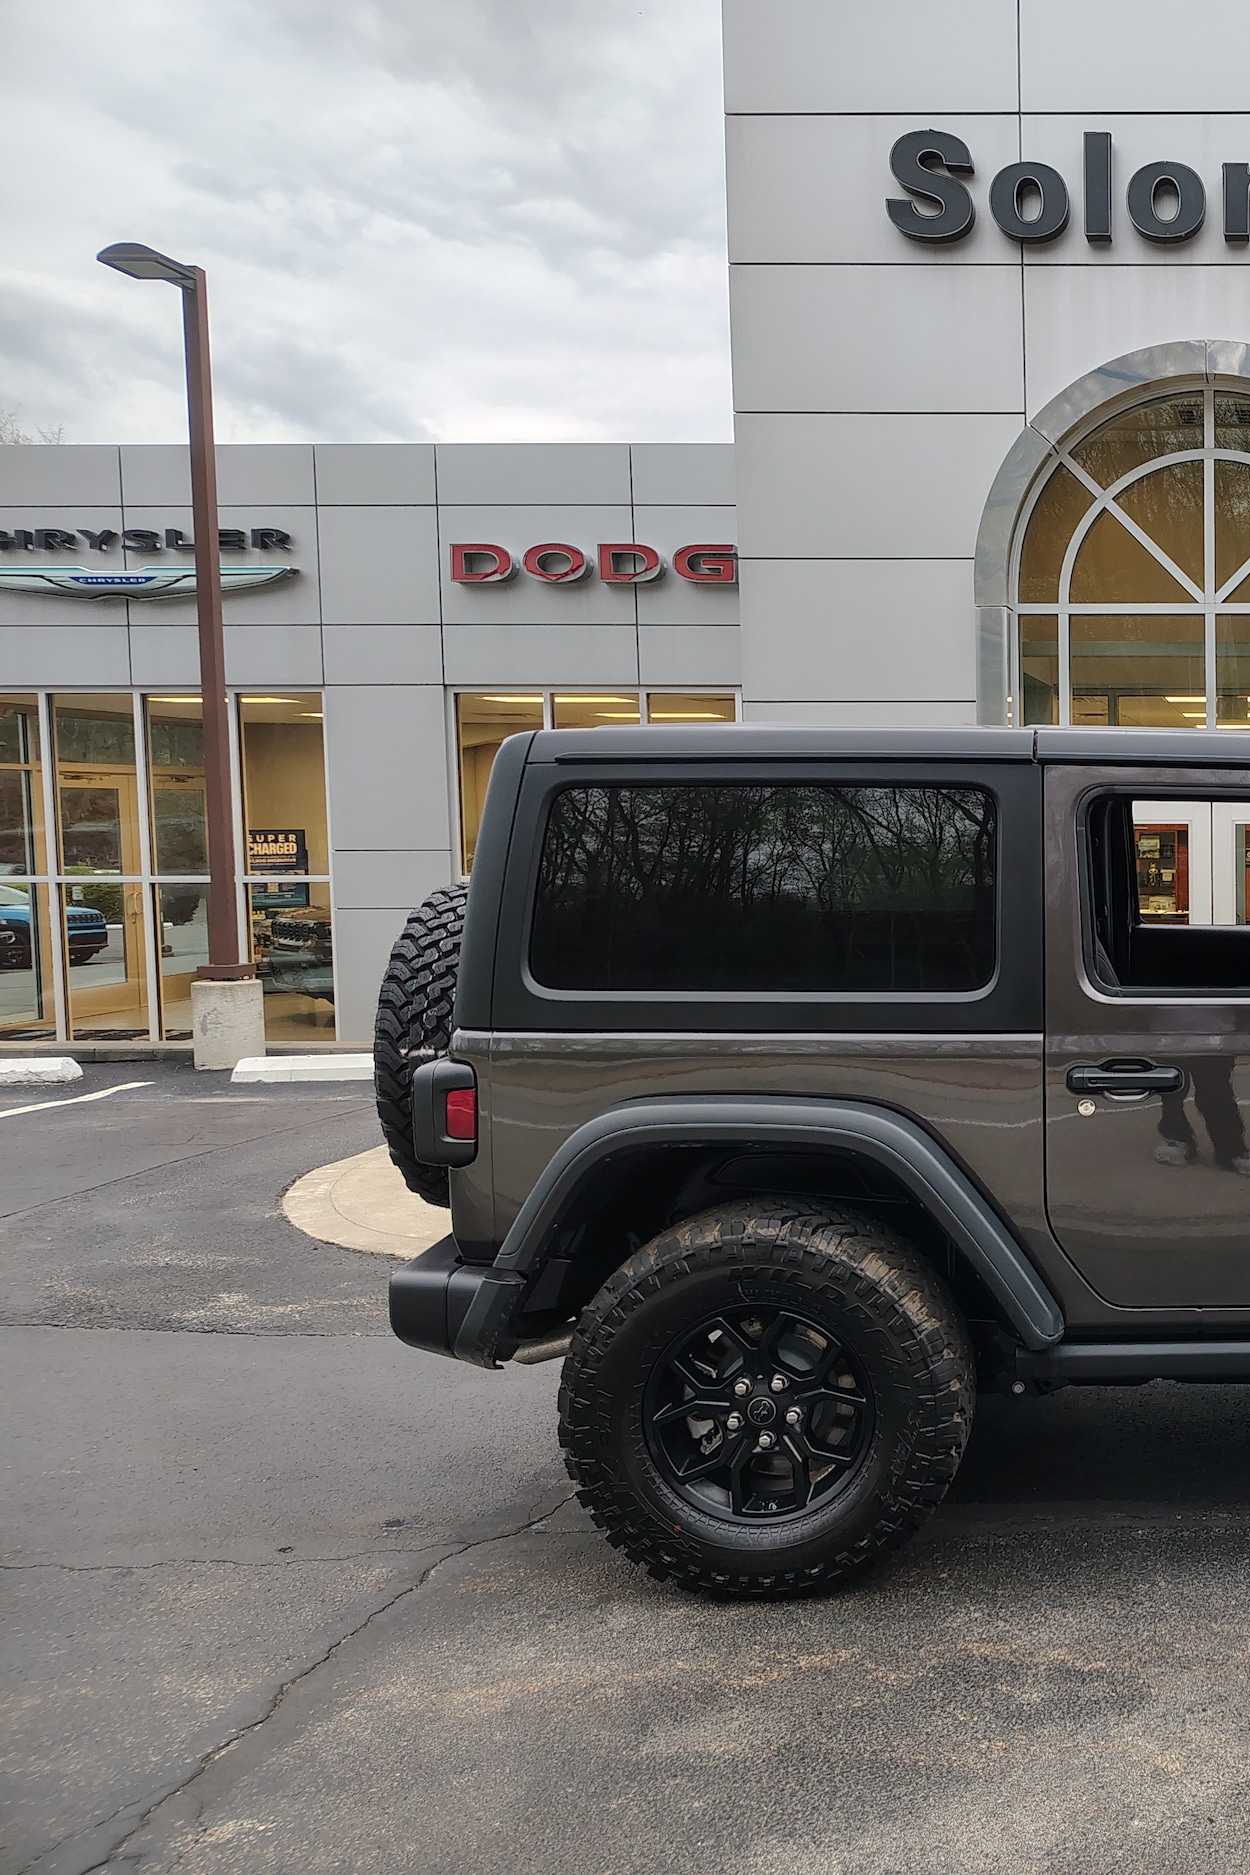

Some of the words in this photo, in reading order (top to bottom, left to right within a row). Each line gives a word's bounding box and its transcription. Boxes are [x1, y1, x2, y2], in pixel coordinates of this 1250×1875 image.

[450, 543, 738, 583] DODG
[248, 834, 296, 842] SUPER
[249, 843, 298, 855] CHARGED
